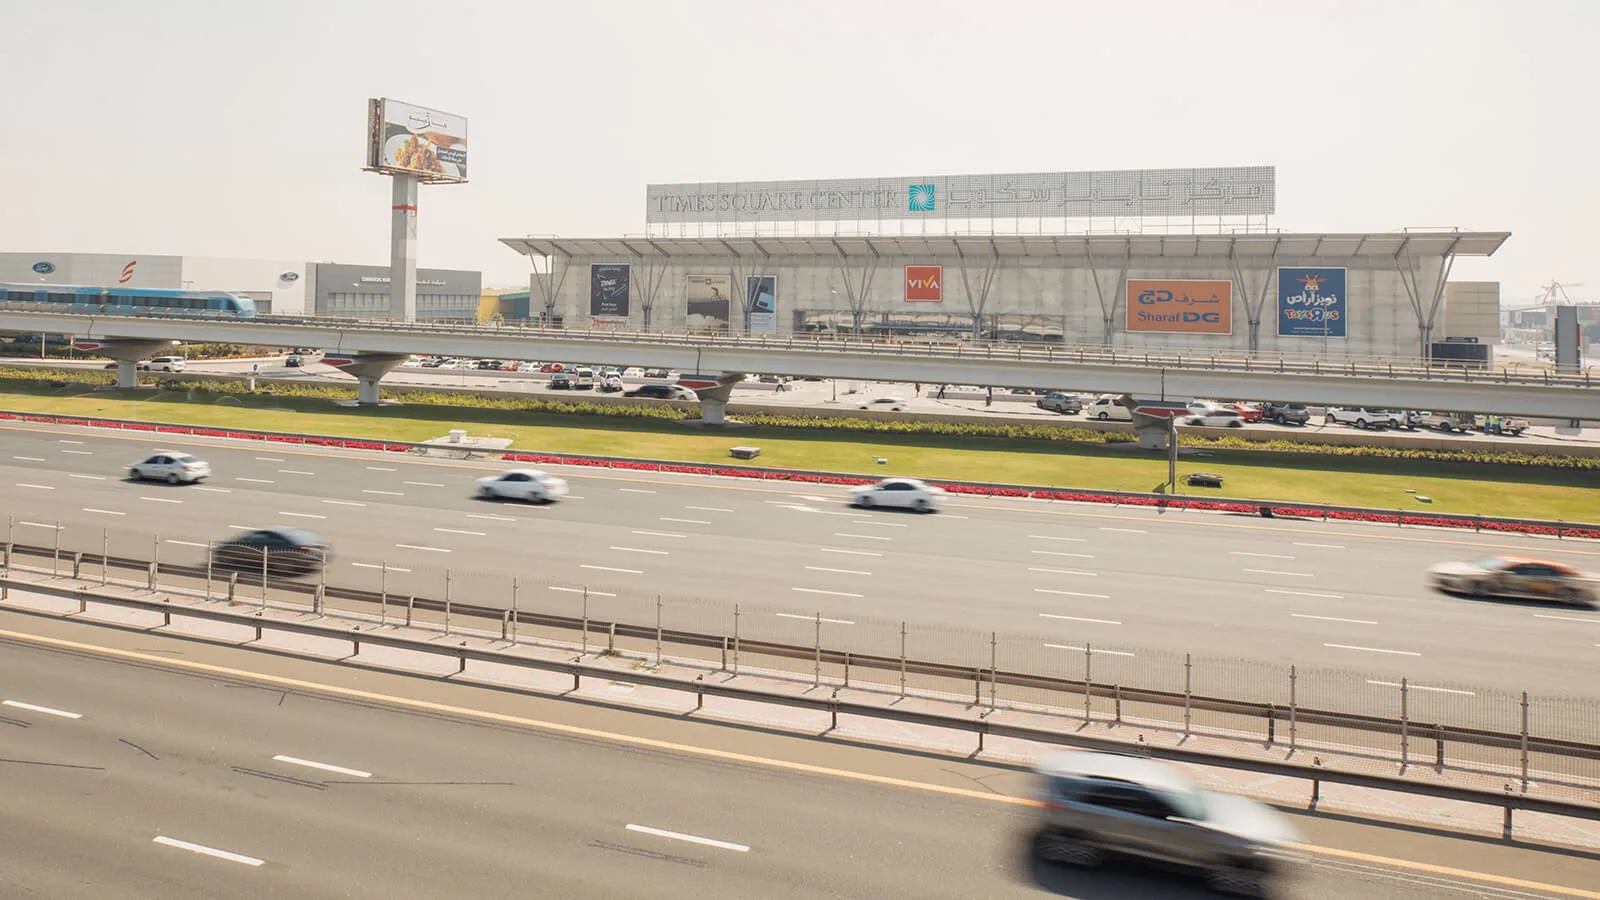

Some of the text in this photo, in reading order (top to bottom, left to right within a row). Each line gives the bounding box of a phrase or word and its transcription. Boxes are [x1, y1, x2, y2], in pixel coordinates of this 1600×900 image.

[655, 189, 899, 215] TIMES SQUARE CENTER
[908, 274, 940, 289] VIVA
[1175, 292, 1220, 306] شرف
[1137, 311, 1220, 323] Sharaf DG
